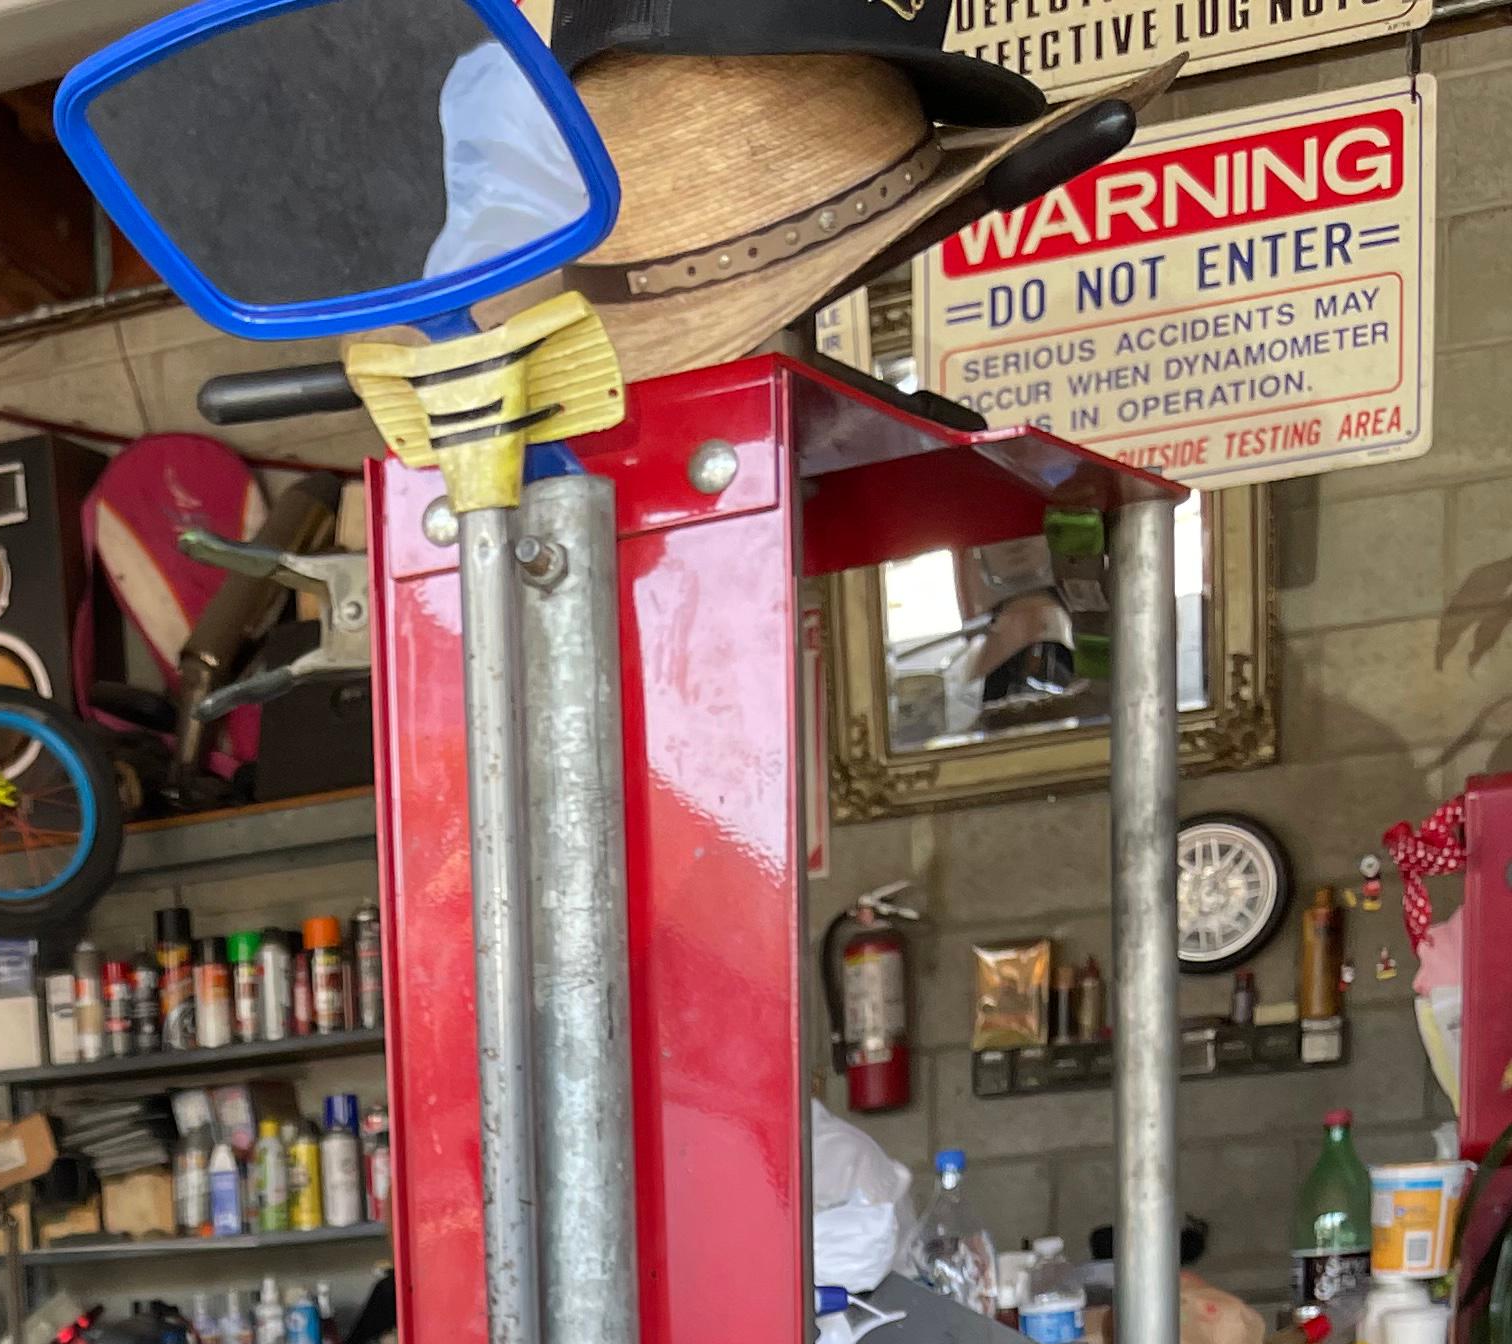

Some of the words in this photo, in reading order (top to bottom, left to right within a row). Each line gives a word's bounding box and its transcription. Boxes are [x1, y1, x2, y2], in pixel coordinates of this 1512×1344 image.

[955, 127, 1392, 266] WARNING
[988, 278, 1046, 328] DO
[1078, 255, 1166, 312] NOT
[1198, 222, 1354, 290] ENTER
[963, 338, 1097, 383] SERIOUS
[1116, 302, 1295, 354] ACCIDENTS
[1315, 287, 1381, 319] MAY
[1069, 363, 1150, 397] WHEN
[1166, 321, 1389, 381] DYNAMOMETER
[1070, 405, 1099, 433] IN
[1118, 372, 1313, 424] OPERATION.
[1226, 418, 1322, 458] TESTING
